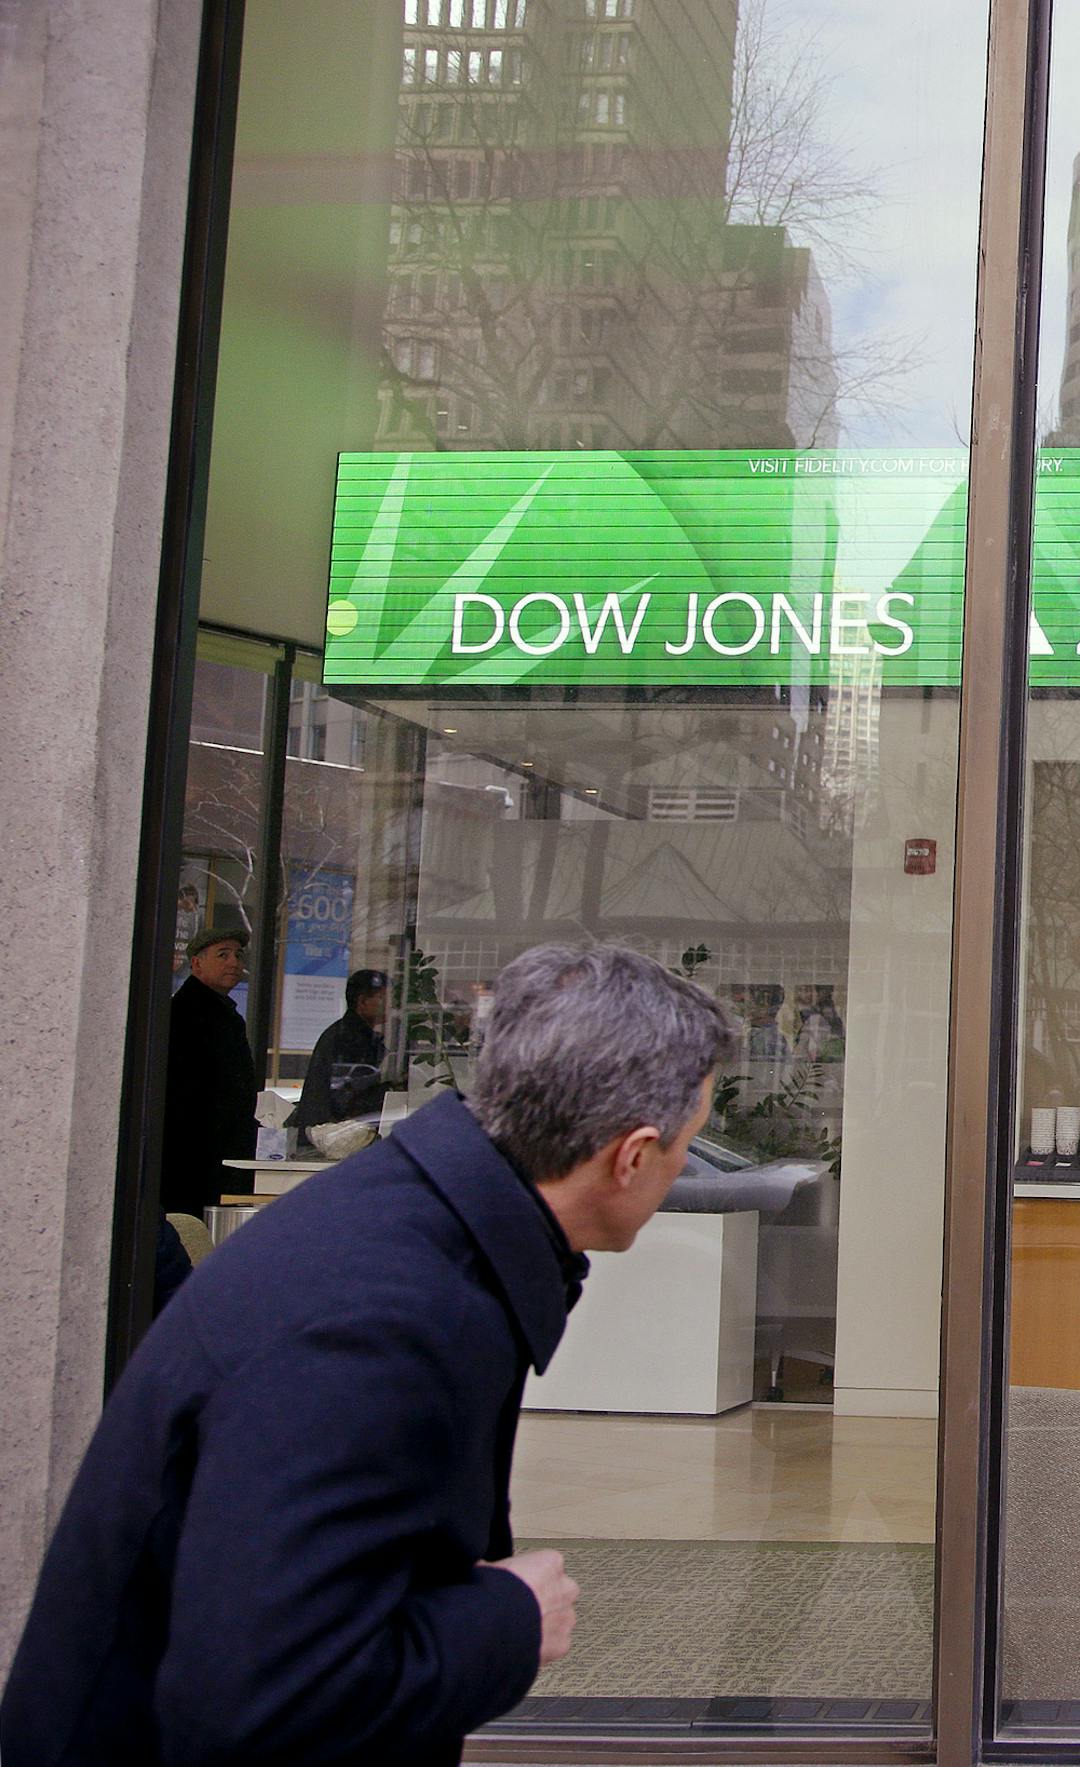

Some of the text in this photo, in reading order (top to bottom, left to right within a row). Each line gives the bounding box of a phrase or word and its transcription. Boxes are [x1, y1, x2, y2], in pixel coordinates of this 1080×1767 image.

[748, 458, 787, 474] VISIT
[795, 458, 913, 474] FIDELITY.COM
[919, 458, 960, 474] FOR
[451, 592, 651, 656] DOW
[664, 592, 915, 657] JONES
